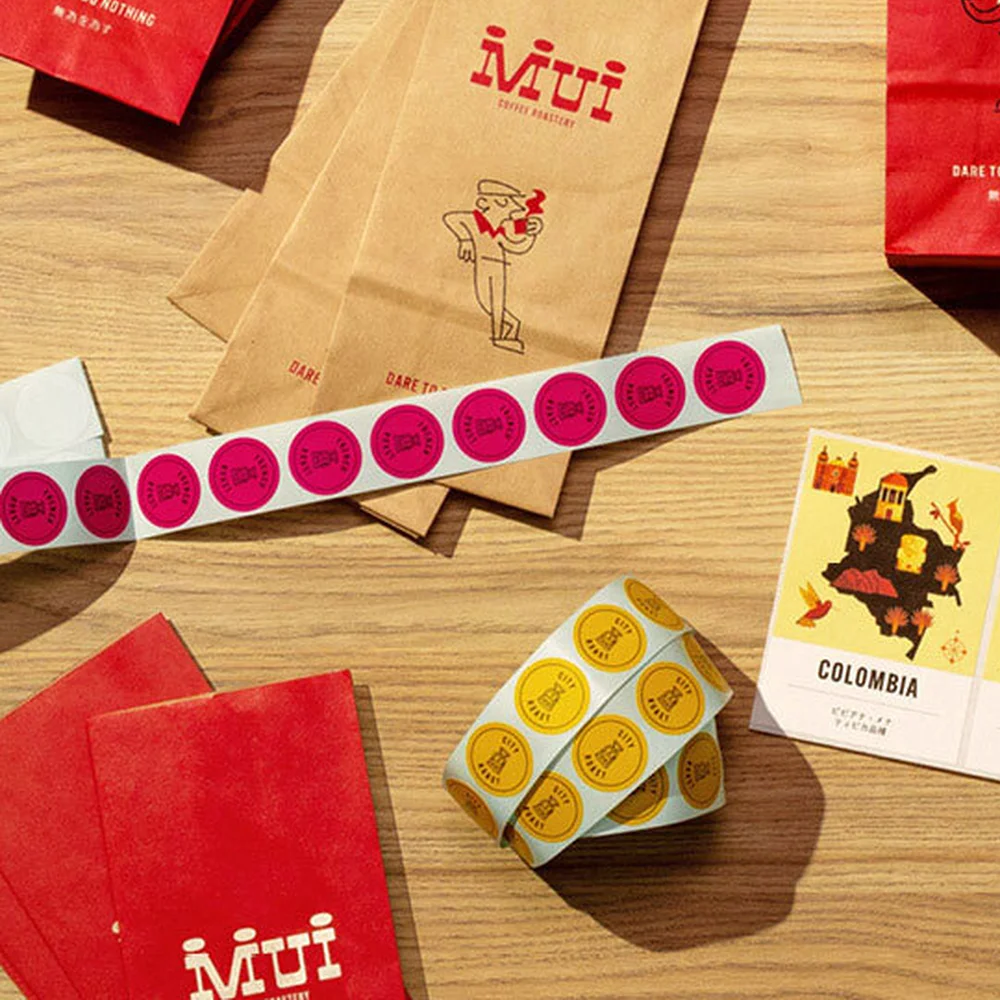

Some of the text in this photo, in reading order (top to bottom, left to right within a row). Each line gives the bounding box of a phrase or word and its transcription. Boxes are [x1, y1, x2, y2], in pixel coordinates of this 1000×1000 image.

[498, 99, 576, 129] COFFEE ROASTERY
[952, 165, 985, 178] DARE
[288, 360, 321, 386] DARE
[385, 371, 418, 392] DARE
[817, 658, 919, 699] COLOMBIA
